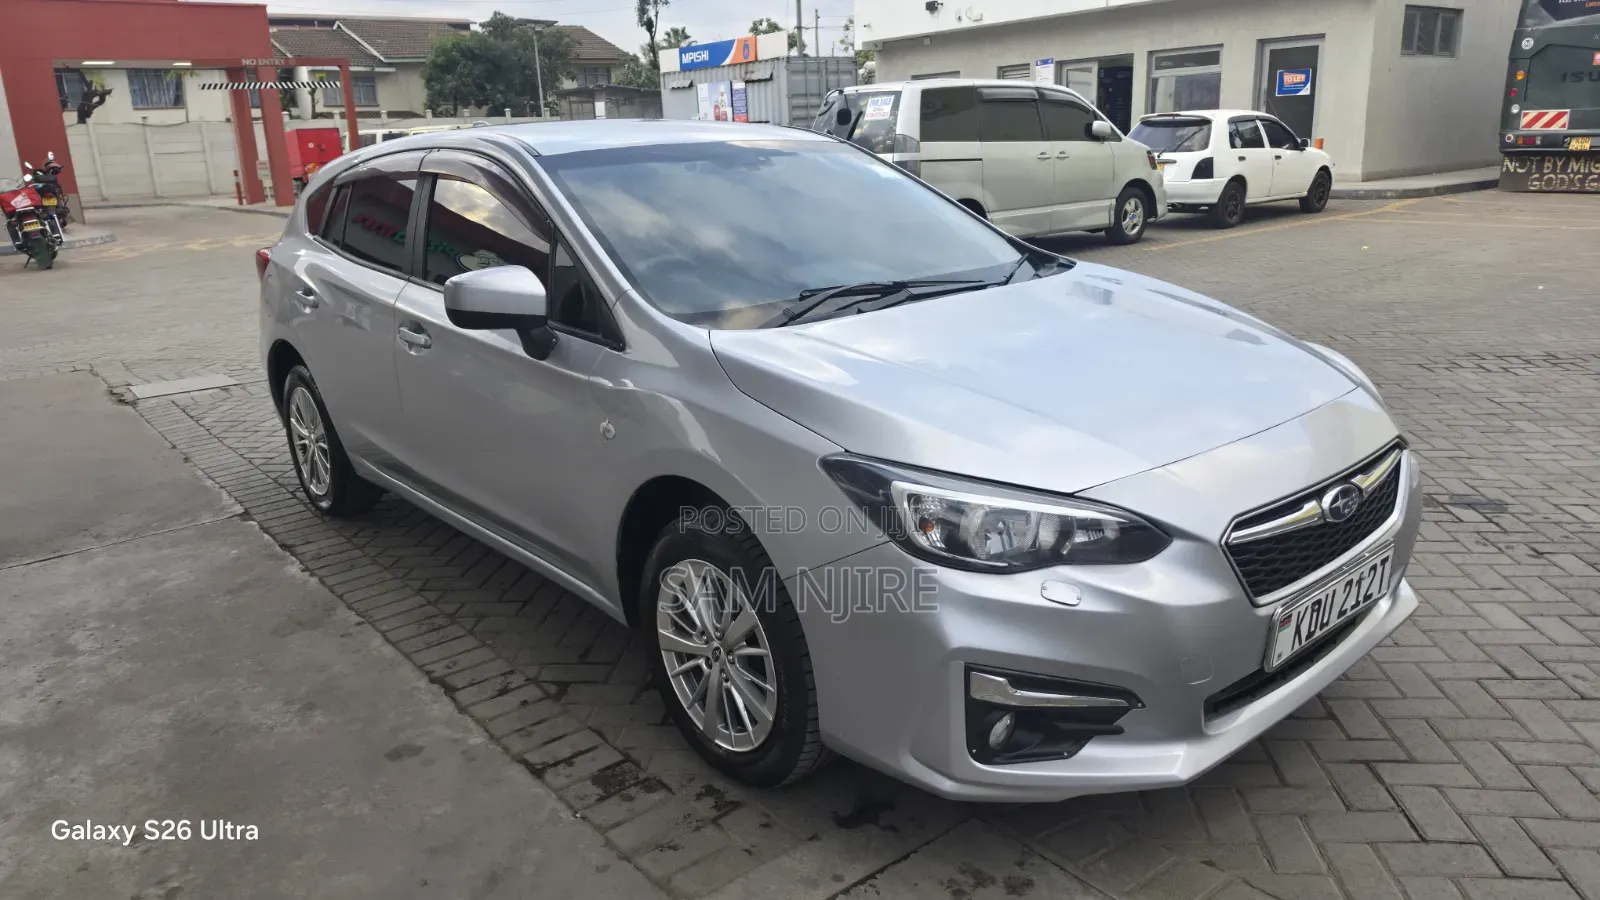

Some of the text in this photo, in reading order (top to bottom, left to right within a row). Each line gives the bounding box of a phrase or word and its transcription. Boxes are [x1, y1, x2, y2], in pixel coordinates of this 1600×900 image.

[242, 58, 284, 66] NO ENTRY
[681, 49, 709, 64] MPISHI
[1502, 156, 1540, 173] NOT
[1543, 156, 1566, 173] BY
[1528, 174, 1583, 189] GOD'S
[1291, 555, 1390, 651] KDU 212T
